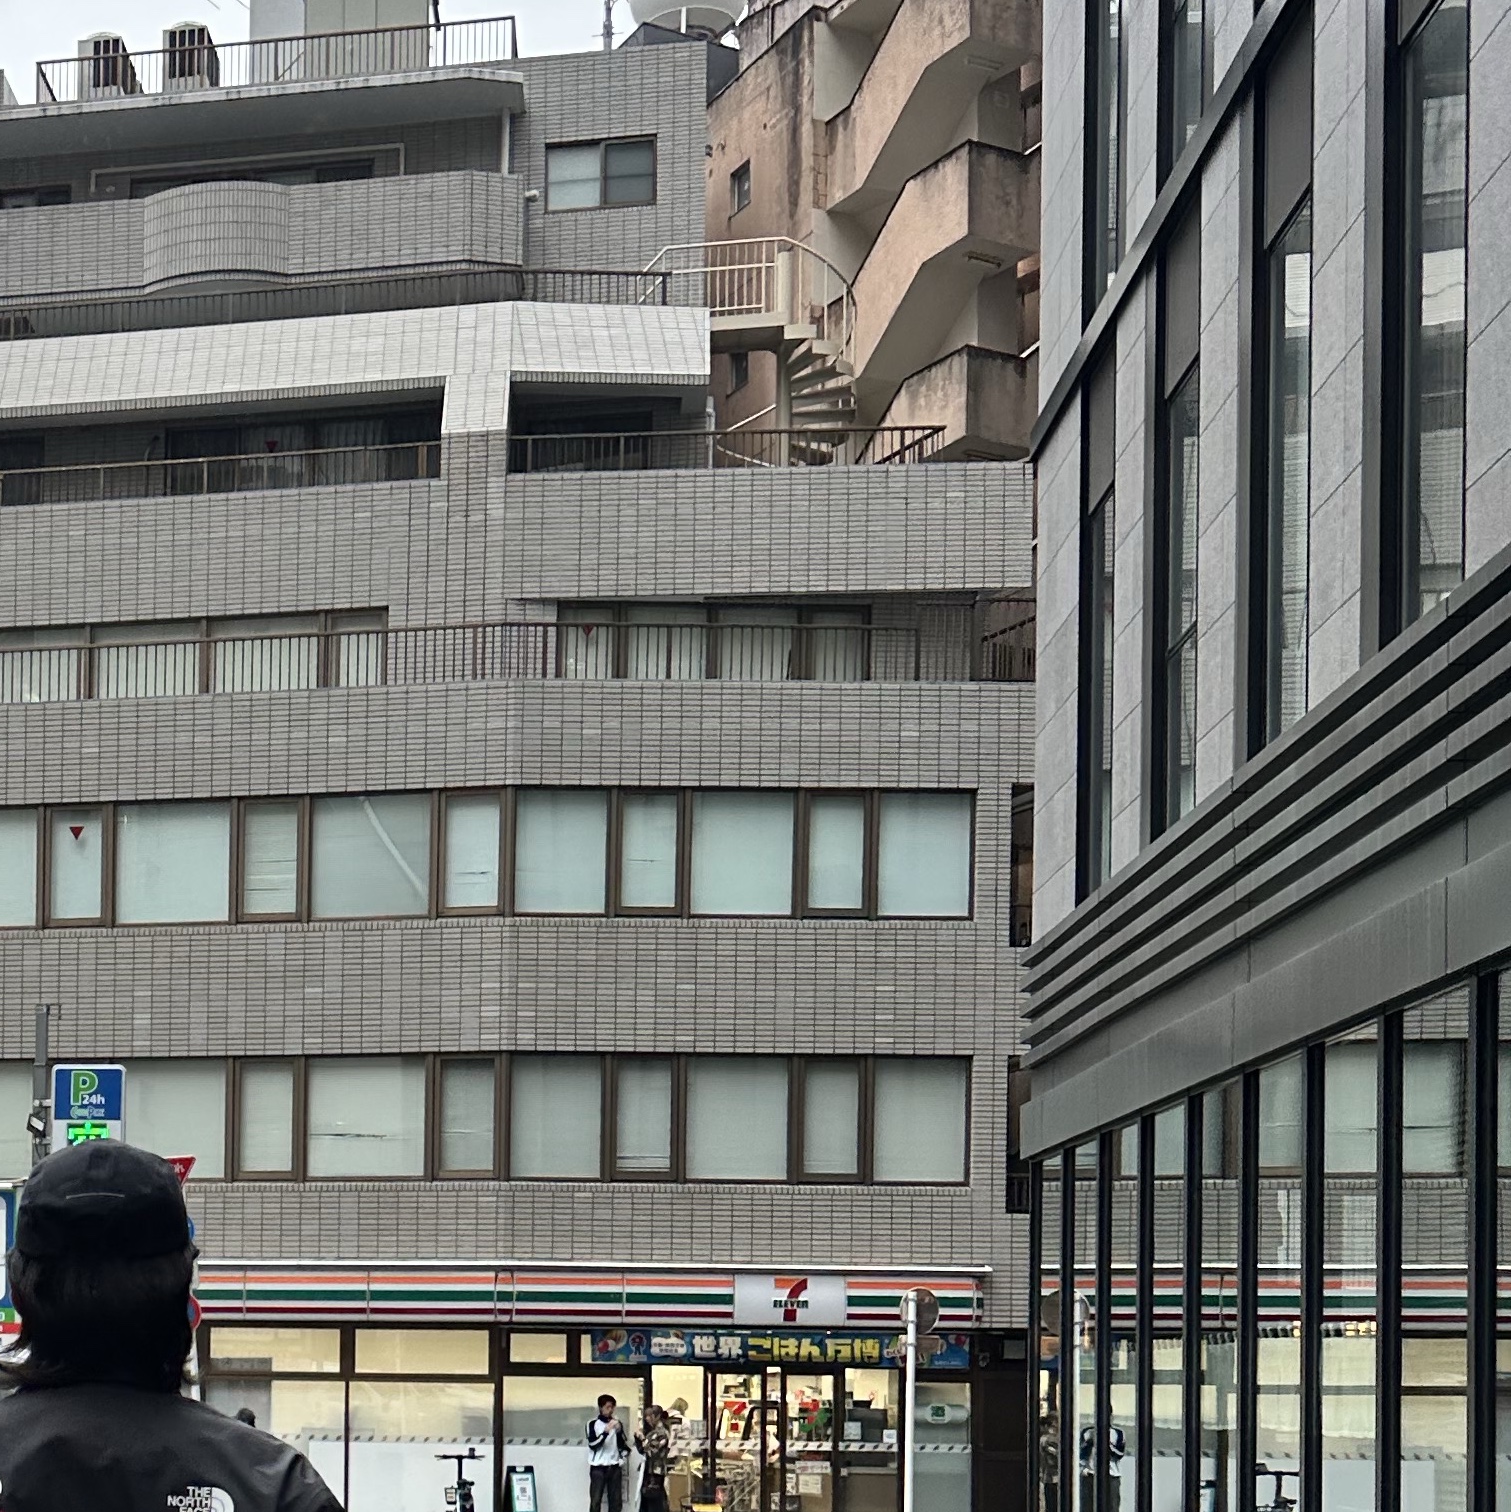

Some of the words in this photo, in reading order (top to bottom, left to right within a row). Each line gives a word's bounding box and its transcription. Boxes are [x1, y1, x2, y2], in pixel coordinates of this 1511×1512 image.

[71, 1071, 98, 1105] P
[82, 1094, 105, 1104] 24h
[774, 1277, 808, 1322] 7
[187, 1486, 211, 1498] THE
[167, 1495, 211, 1508] NORTH
